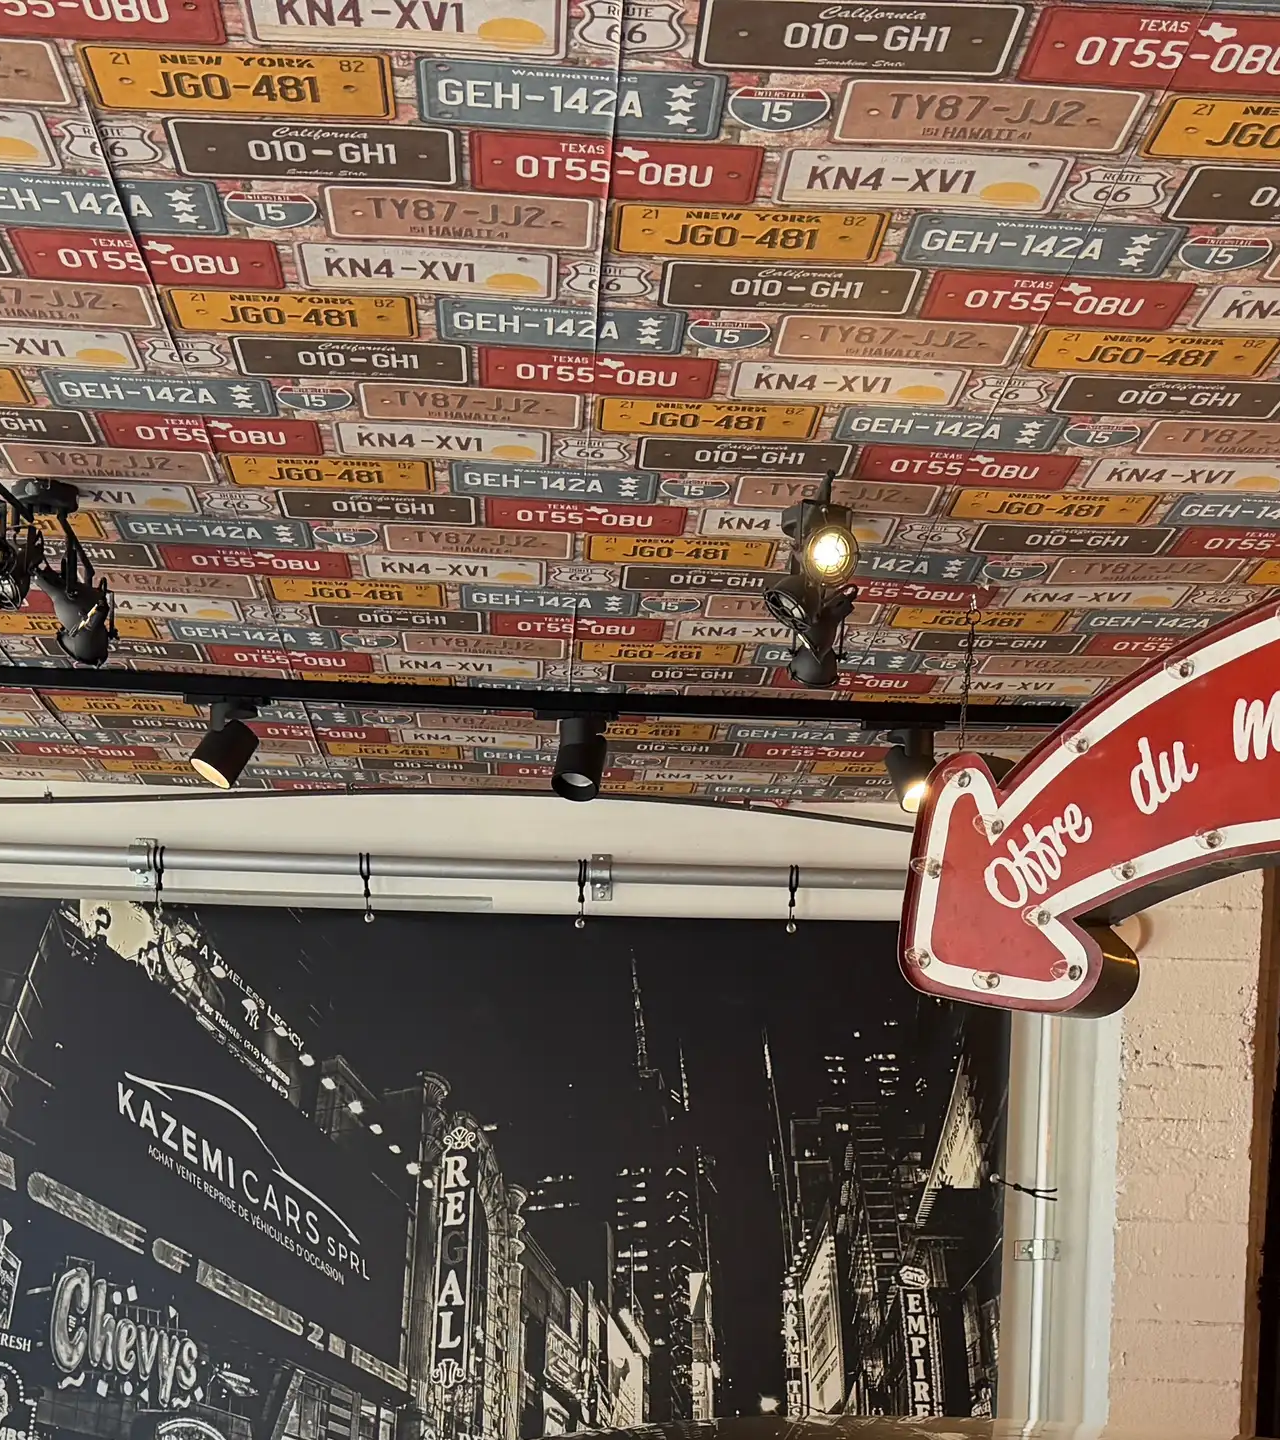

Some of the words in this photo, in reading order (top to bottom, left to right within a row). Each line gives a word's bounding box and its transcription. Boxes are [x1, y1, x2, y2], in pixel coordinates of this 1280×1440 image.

[609, 3, 654, 17] ROUTE
[818, 7, 925, 22] California
[607, 22, 648, 44] 66
[1140, 20, 1196, 35] TEXAS
[110, 53, 130, 66] 21
[160, 55, 222, 65] NEW
[238, 56, 315, 68] YORK
[339, 59, 365, 74] 82
[512, 69, 612, 83] WASHINGTON
[440, 79, 641, 117] GEH-142A
[762, 101, 793, 122] 15
[893, 91, 1085, 128] TY87-JJ2
[1190, 105, 1212, 117] 21
[272, 126, 368, 139] California
[560, 143, 608, 155] TEXAS
[1103, 171, 1146, 182] ROUTE
[1093, 185, 1130, 202] 66
[255, 203, 286, 221] 15
[923, 229, 1101, 259] GEH-142A
[1205, 247, 1239, 264] 15
[983, 800, 1093, 910] Offre
[1130, 736, 1200, 815] du
[117, 1081, 235, 1189] KAZEMI
[242, 1169, 320, 1246] CARS
[326, 1235, 371, 1282] SPRL
[148, 1143, 175, 1170] ACHAT
[175, 1158, 203, 1191] VENTE
[203, 1181, 237, 1213] REPRISE
[237, 1203, 250, 1222] DE
[250, 1209, 295, 1253] VÉHICULES
[295, 1243, 345, 1286] D'OCCASION
[436, 1154, 471, 1350] REGAL
[50, 1265, 198, 1408] Chevys
[905, 1292, 933, 1418] EMPIRE
